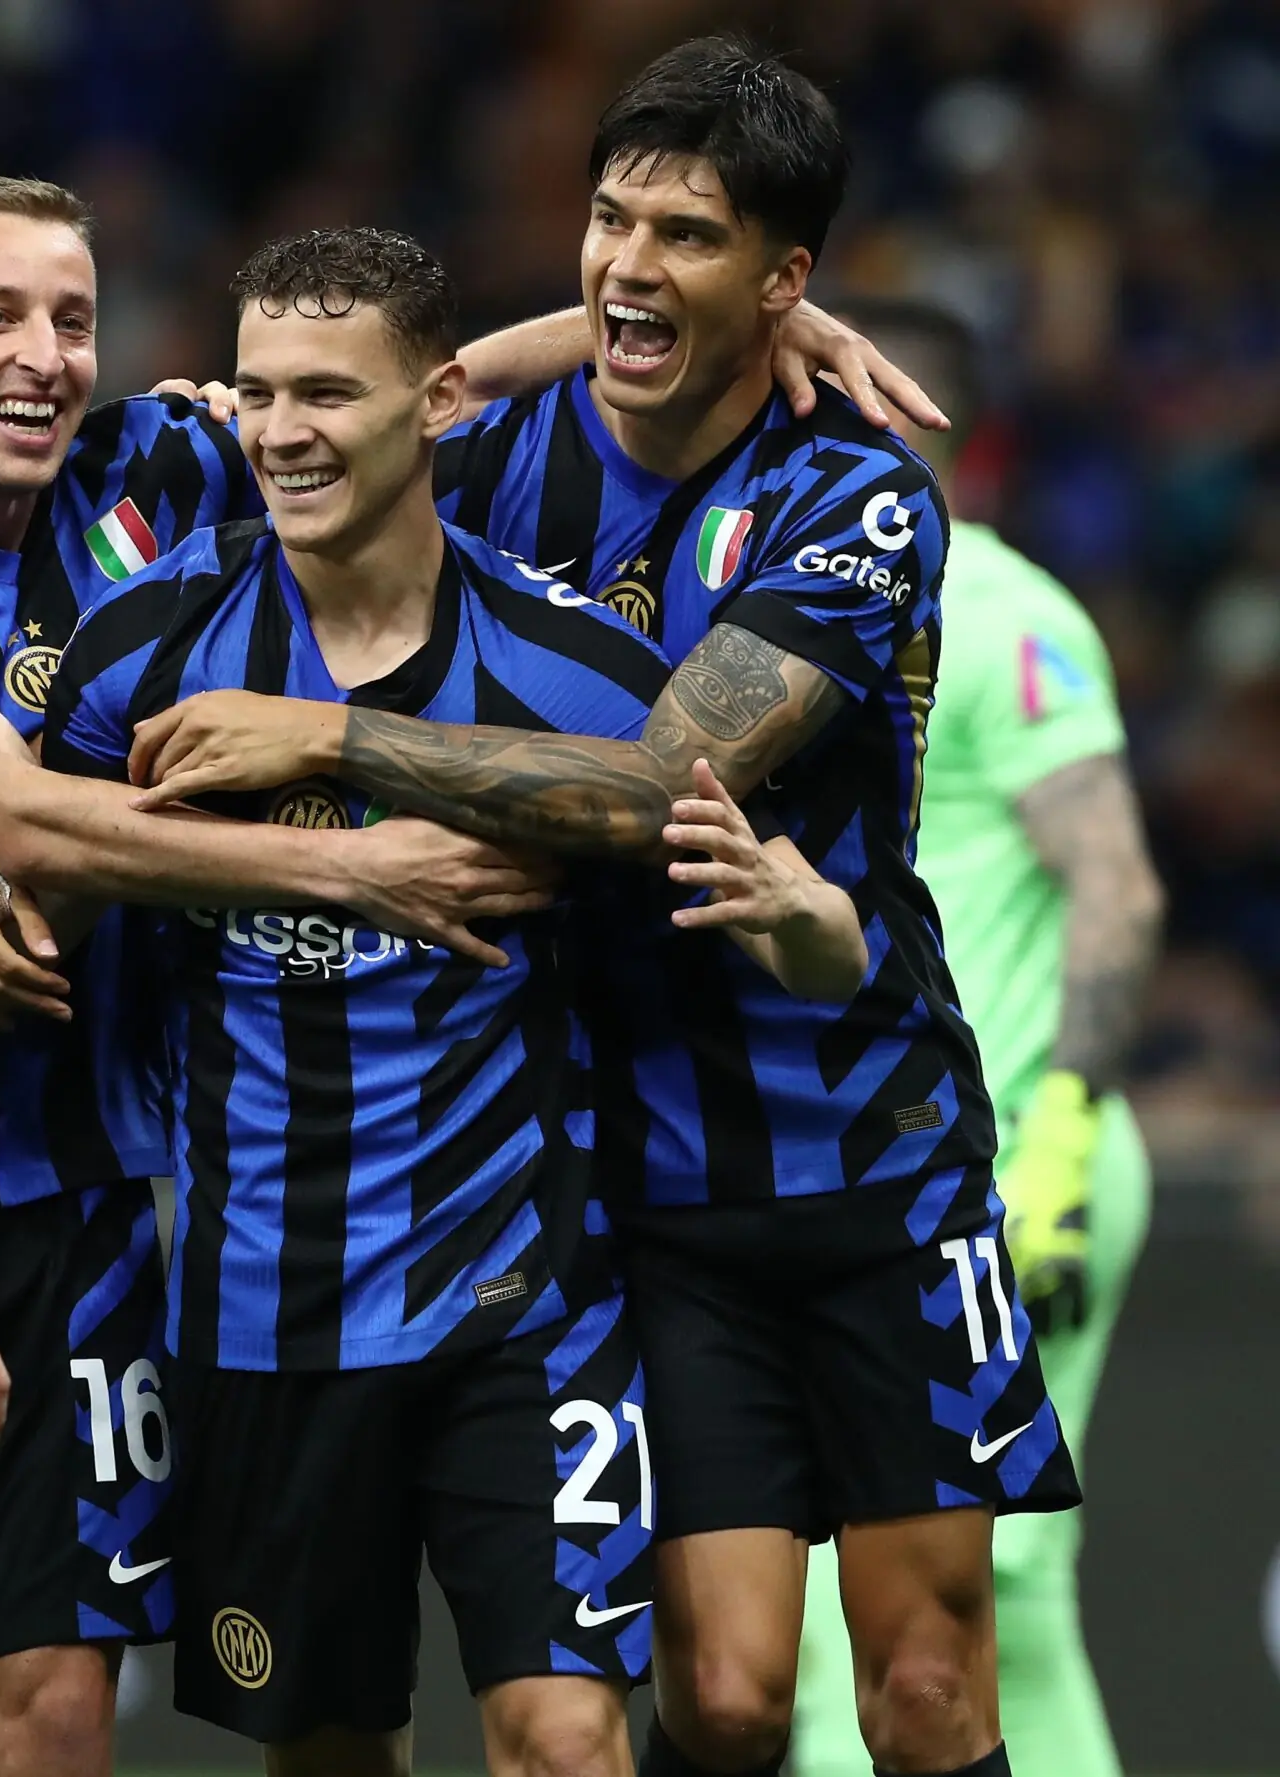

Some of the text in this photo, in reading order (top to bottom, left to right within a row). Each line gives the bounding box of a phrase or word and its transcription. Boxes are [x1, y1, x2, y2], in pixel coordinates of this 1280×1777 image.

[793, 544, 911, 606] Gate.io
[185, 905, 406, 958] tsso
[940, 1237, 1018, 1363] 11
[70, 1358, 171, 1482] 16
[549, 1400, 652, 1531] 21
